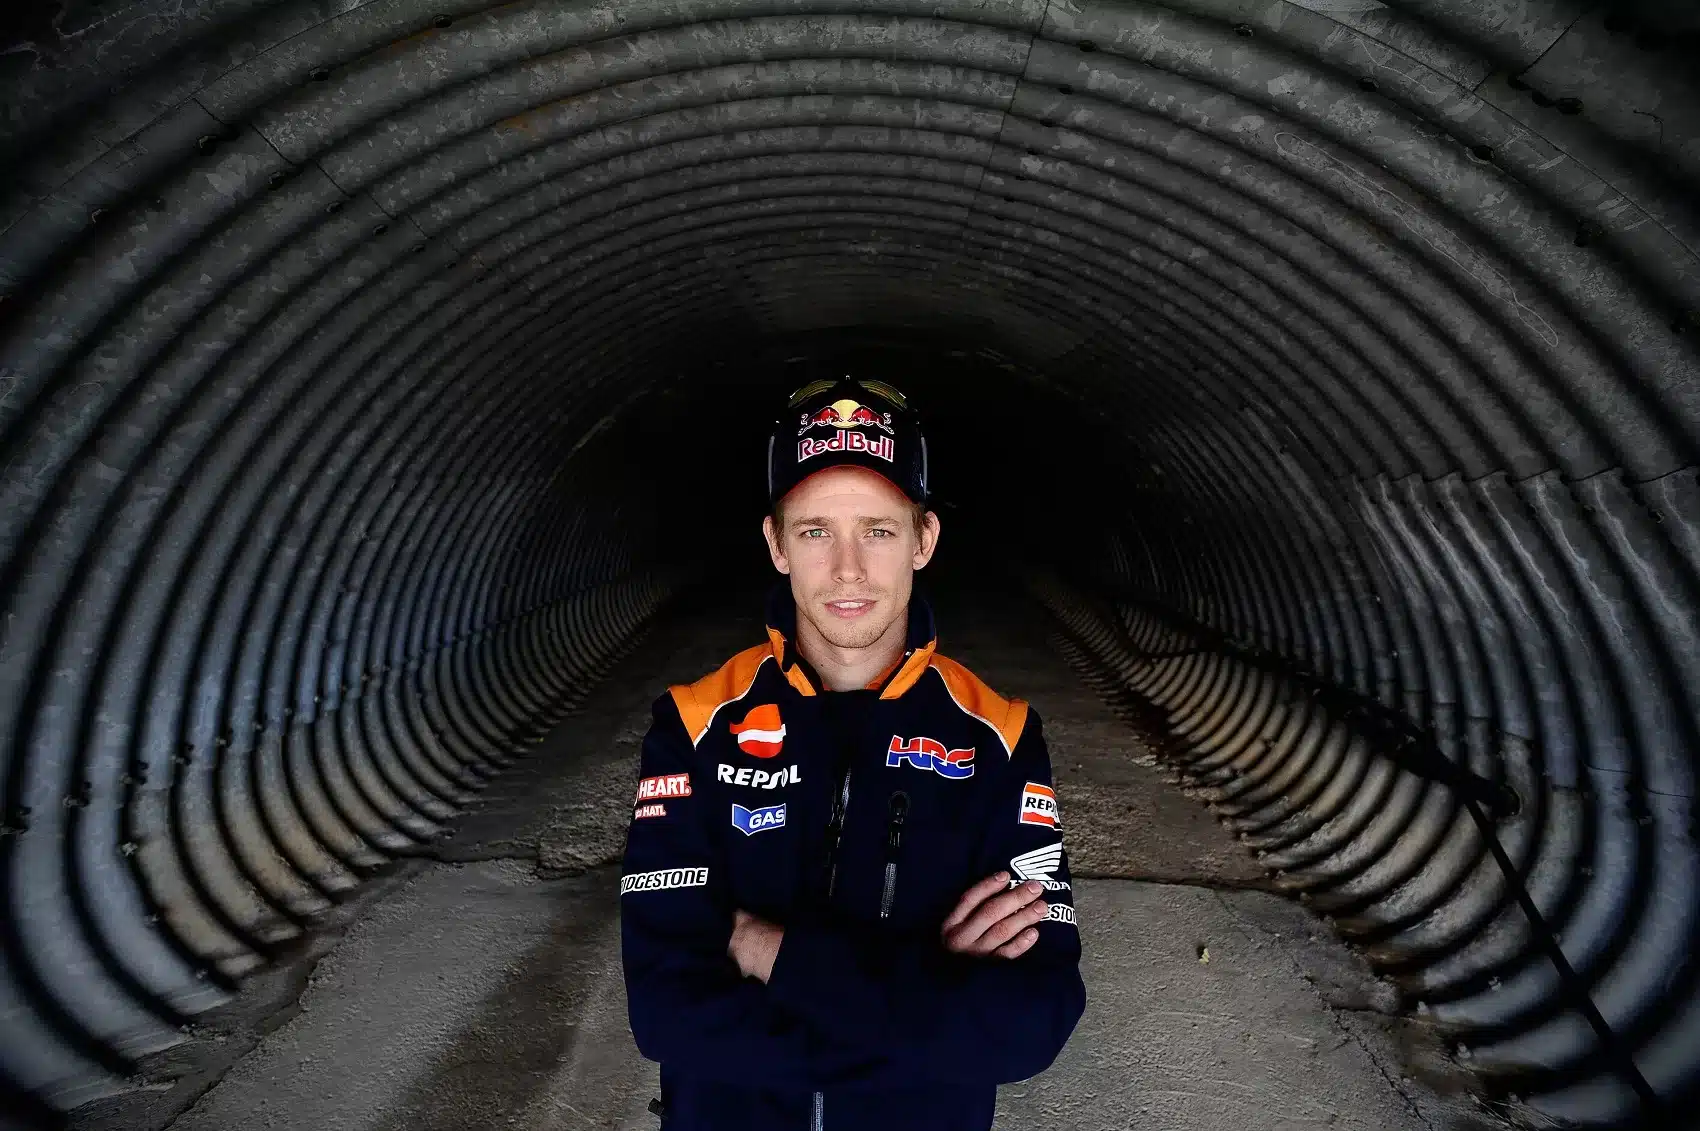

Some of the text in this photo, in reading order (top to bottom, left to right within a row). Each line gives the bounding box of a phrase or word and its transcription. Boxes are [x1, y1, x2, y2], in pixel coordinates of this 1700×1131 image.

[798, 430, 894, 462] Red Bull
[886, 734, 975, 779] HRC
[717, 763, 802, 790] REPSOL
[749, 808, 785, 829] GAS
[621, 869, 707, 893] IDGESTONE
[1009, 879, 1072, 891] HNDA
